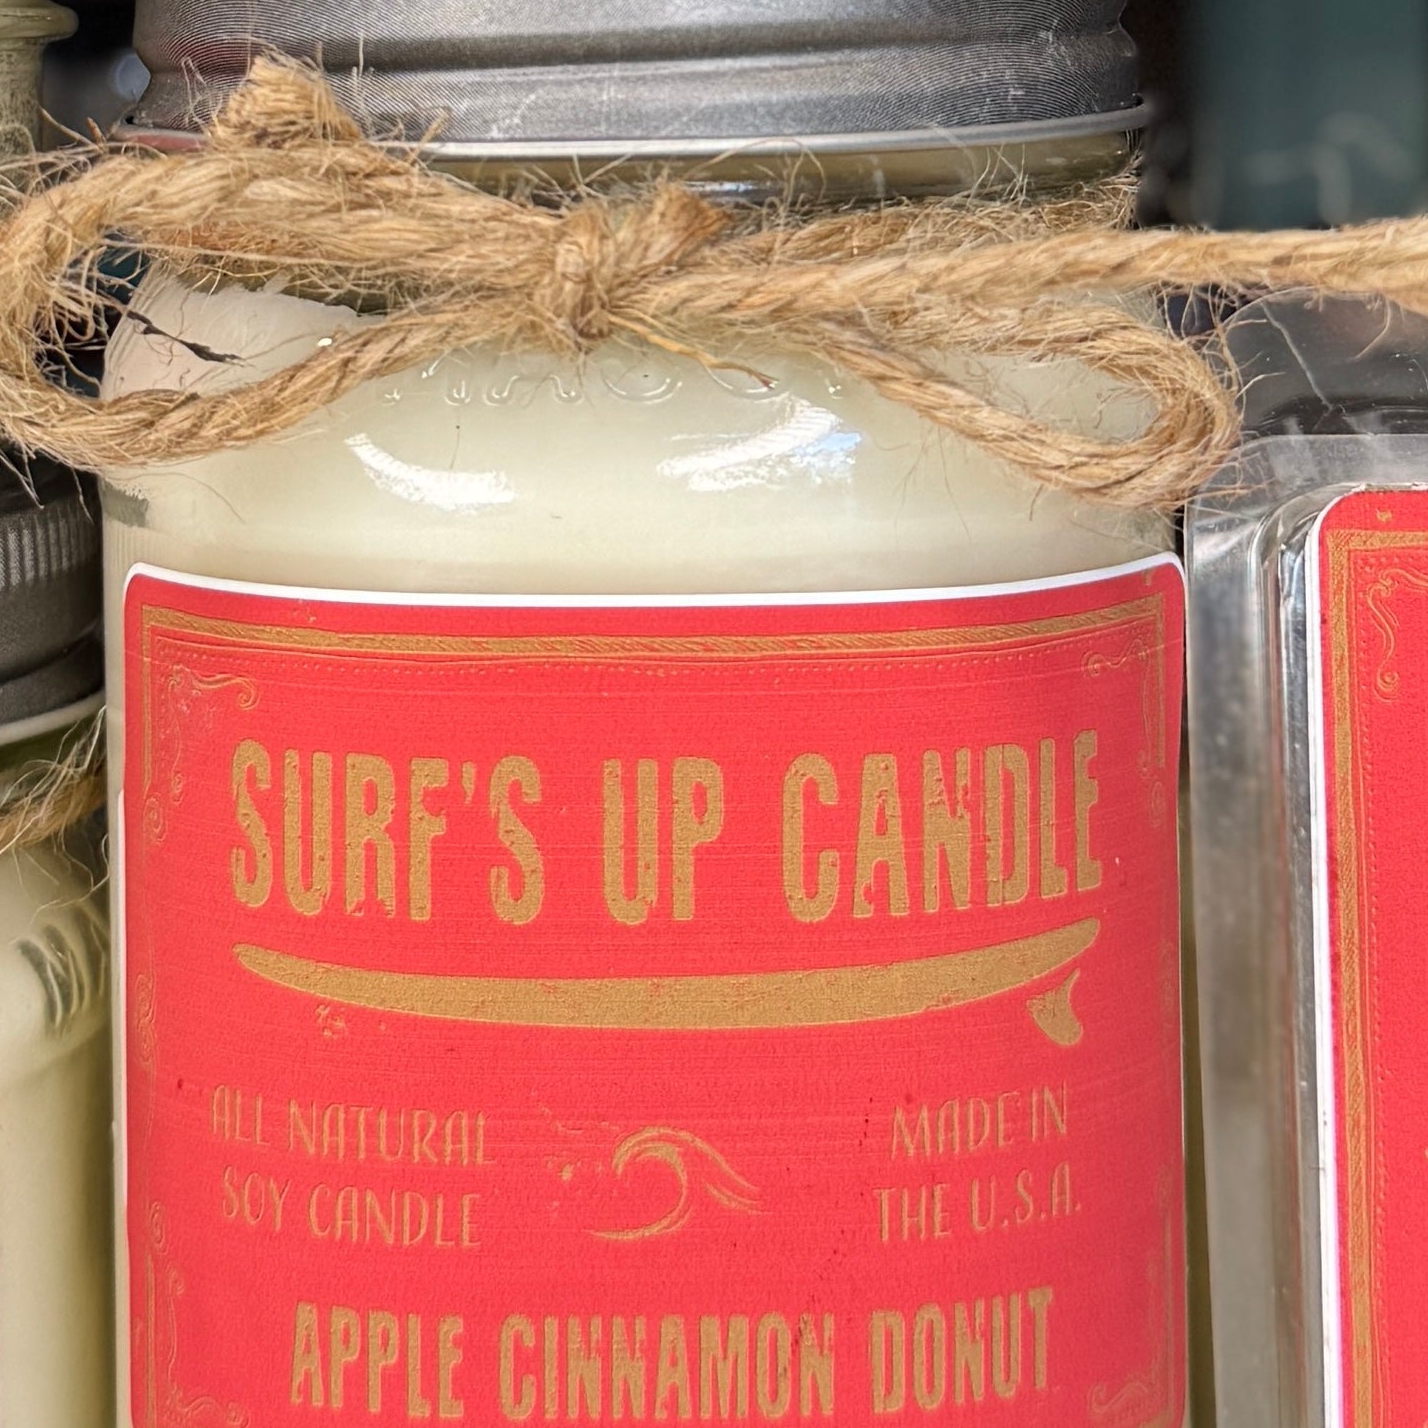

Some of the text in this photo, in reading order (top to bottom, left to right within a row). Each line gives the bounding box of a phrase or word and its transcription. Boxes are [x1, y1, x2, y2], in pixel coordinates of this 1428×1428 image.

[230, 729, 1105, 927] SURF'S UP CANDLE
[211, 1085, 497, 1168] ALL NATURAL
[890, 1081, 1070, 1159] MADE IN
[220, 1166, 484, 1249] SOY CANDLE
[874, 1163, 1082, 1242] THE U.S.A.
[289, 1286, 1056, 1423] APPLE CINNAMON DONUT
